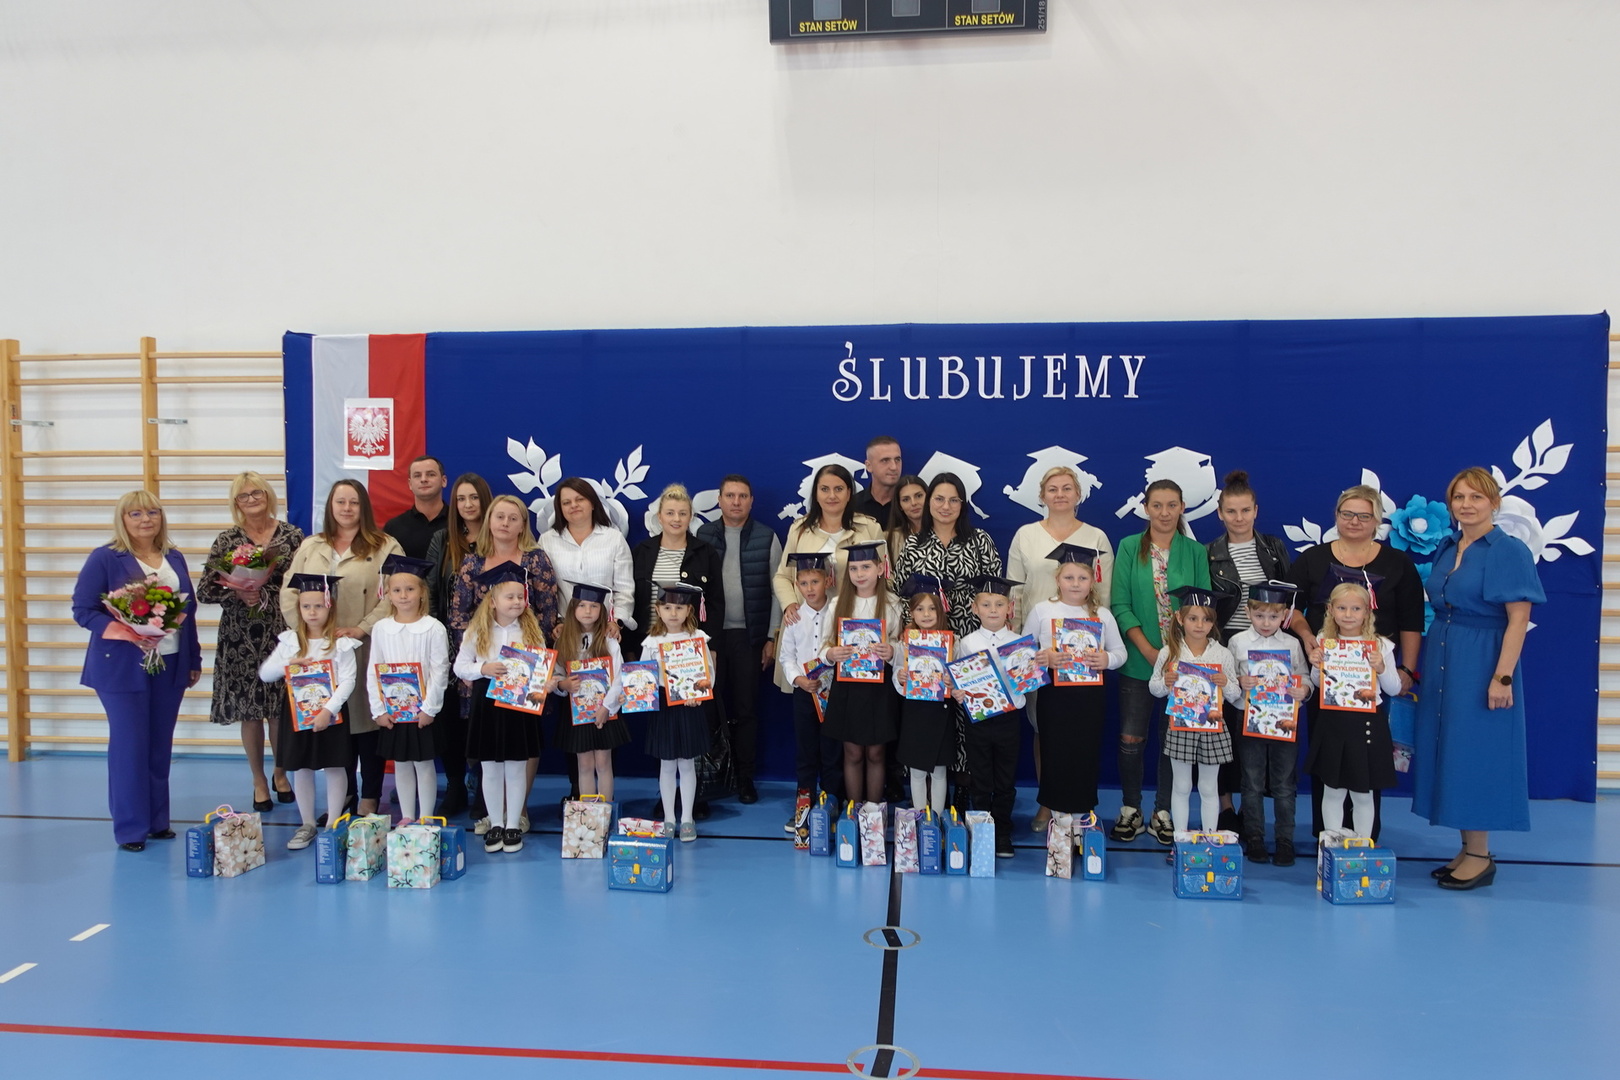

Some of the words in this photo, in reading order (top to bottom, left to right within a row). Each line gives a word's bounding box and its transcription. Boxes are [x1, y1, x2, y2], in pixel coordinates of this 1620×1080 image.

[799, 21, 823, 32] STAN
[825, 18, 857, 32] SETÓW
[955, 15, 979, 26] STAN
[981, 11, 1015, 25] SETÓW
[832, 341, 1146, 402] ŚLUBUJEMY
